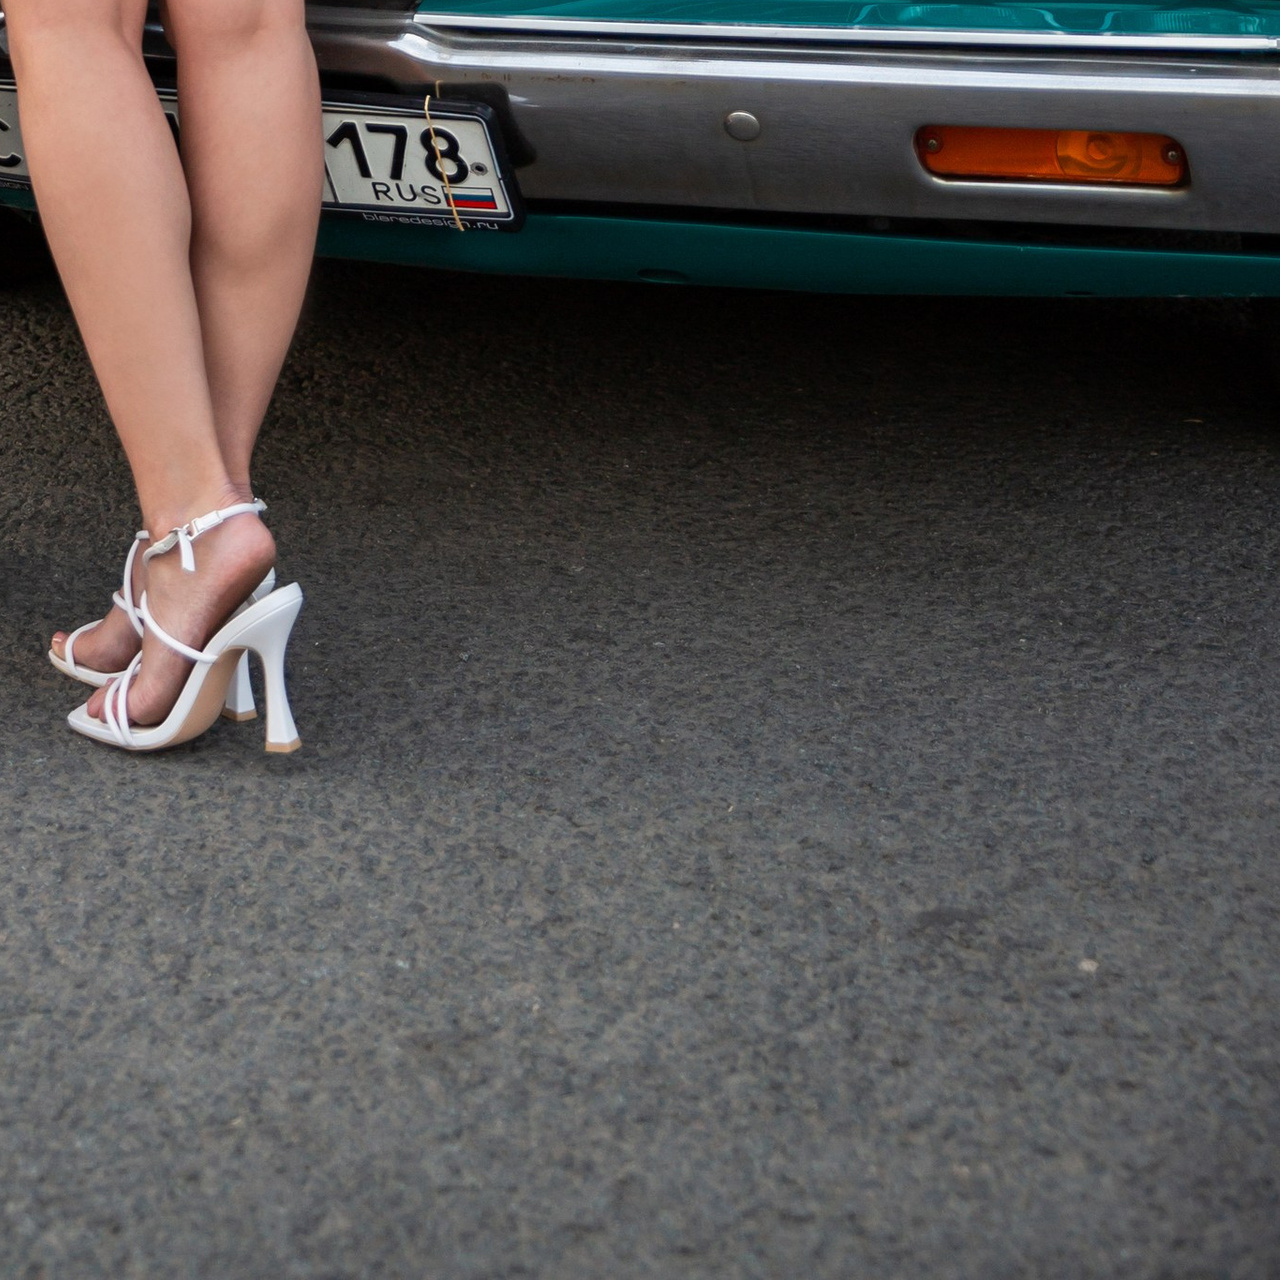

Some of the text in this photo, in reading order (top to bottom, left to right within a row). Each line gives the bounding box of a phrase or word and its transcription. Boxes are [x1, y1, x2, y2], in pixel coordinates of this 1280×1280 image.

[325, 120, 469, 185] 178
[372, 181, 442, 205] RUS
[363, 211, 499, 231] blaredesign.ru
